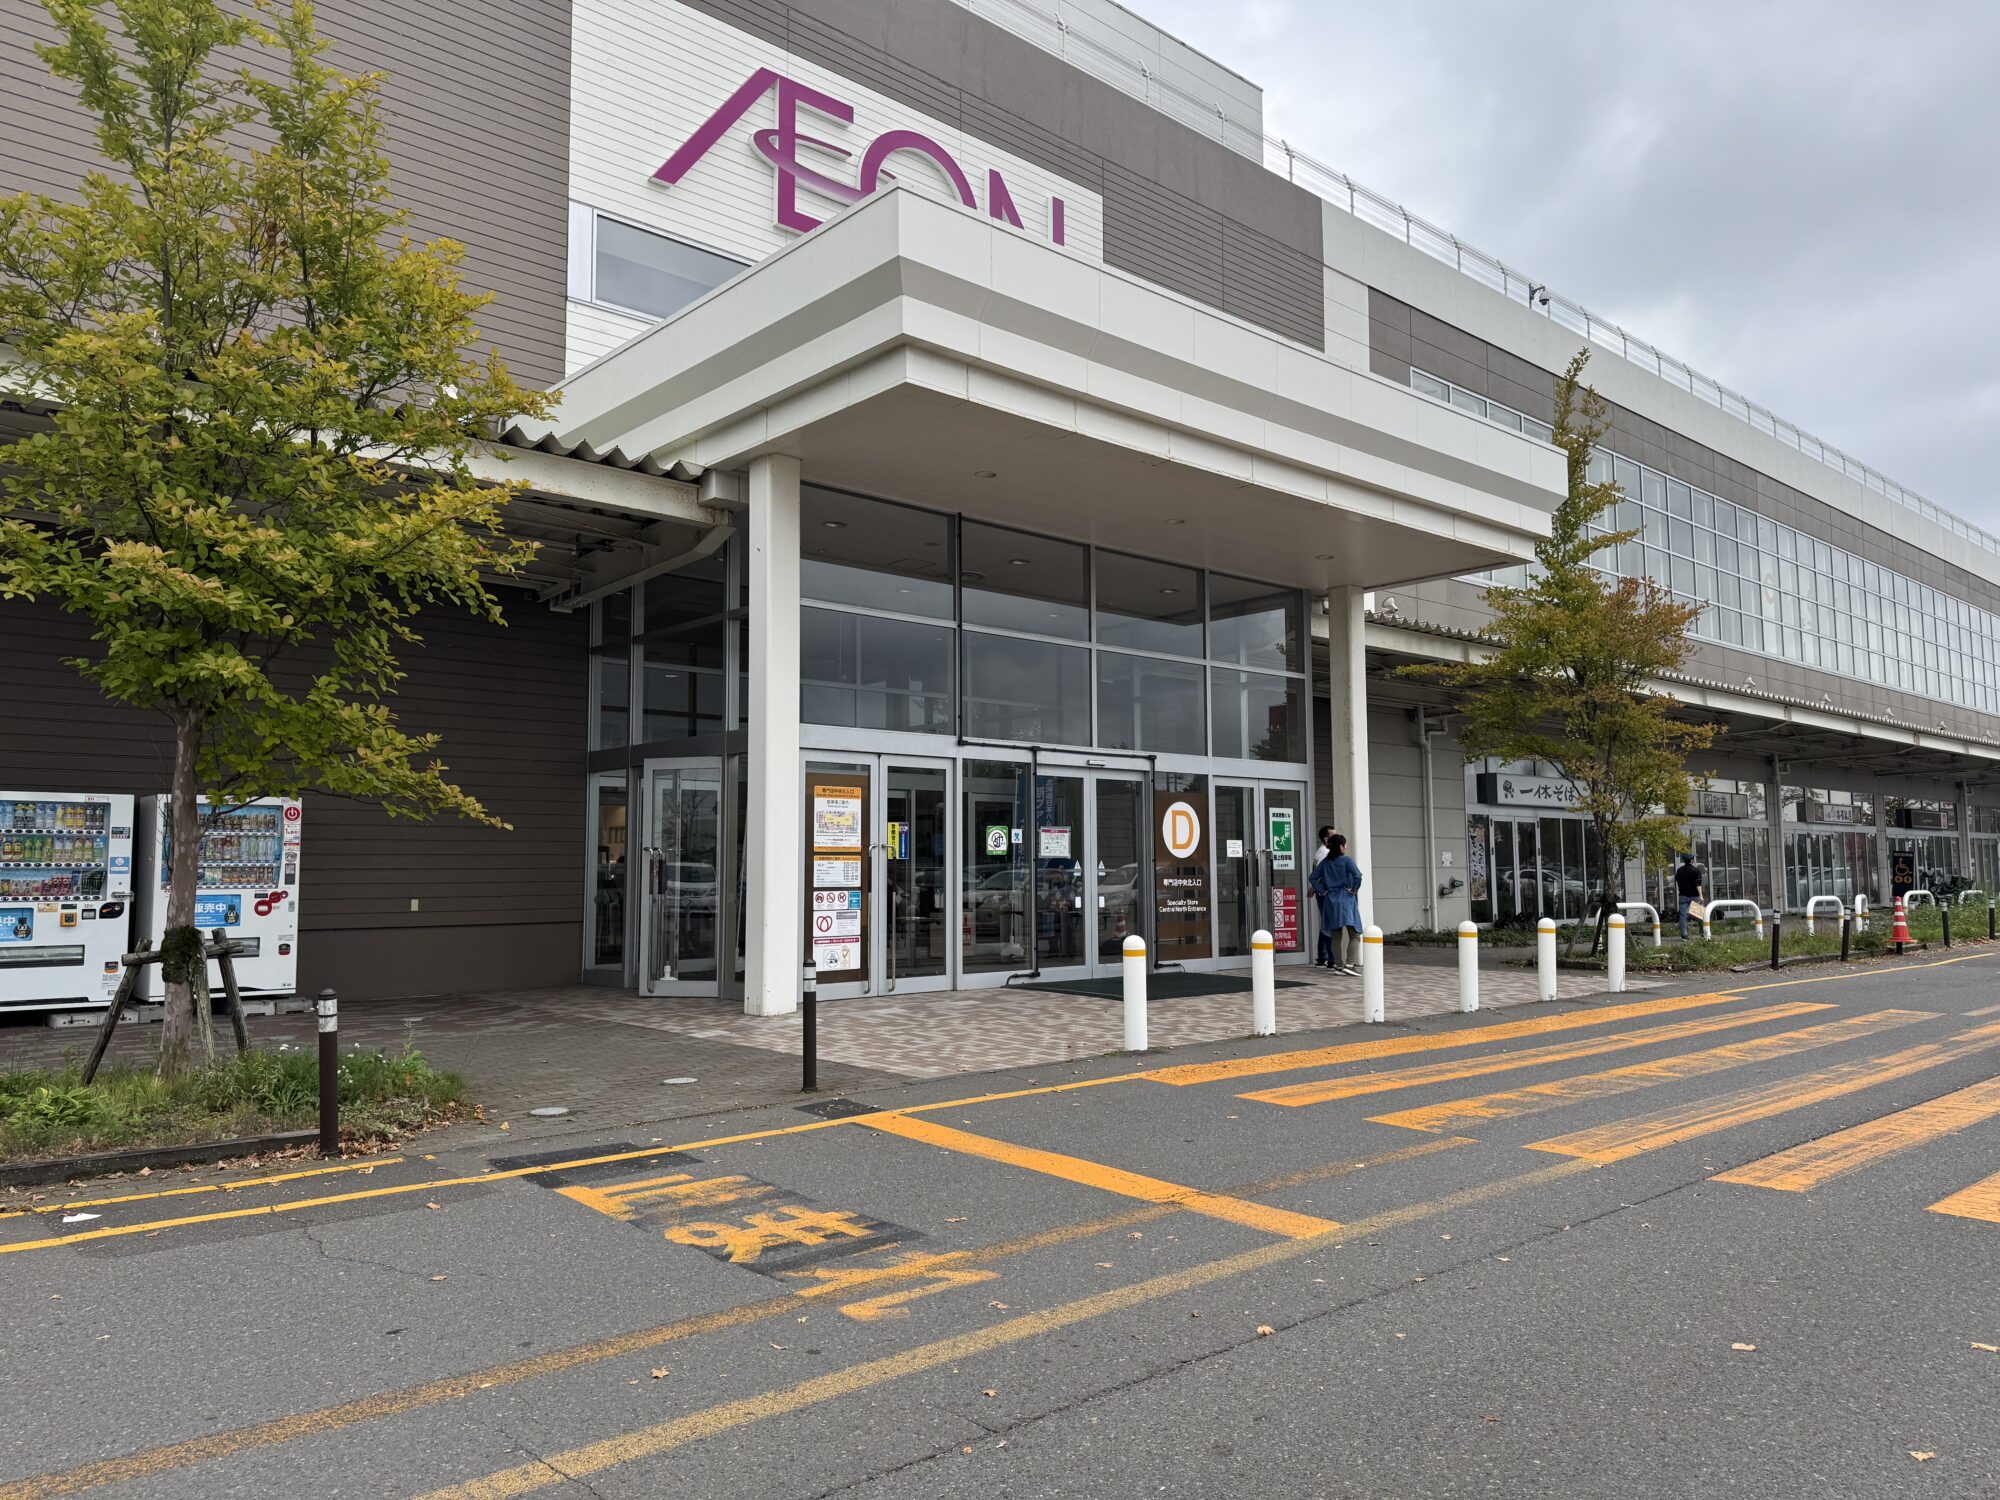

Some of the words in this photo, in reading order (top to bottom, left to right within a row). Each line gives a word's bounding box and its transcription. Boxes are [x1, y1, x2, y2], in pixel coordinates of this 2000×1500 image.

[1519, 784, 1577, 802] 一休そば
[1171, 810, 1194, 849] D
[1163, 878, 1202, 887] 専門店中央北入口
[554, 1173, 1002, 1322] 止まれ
